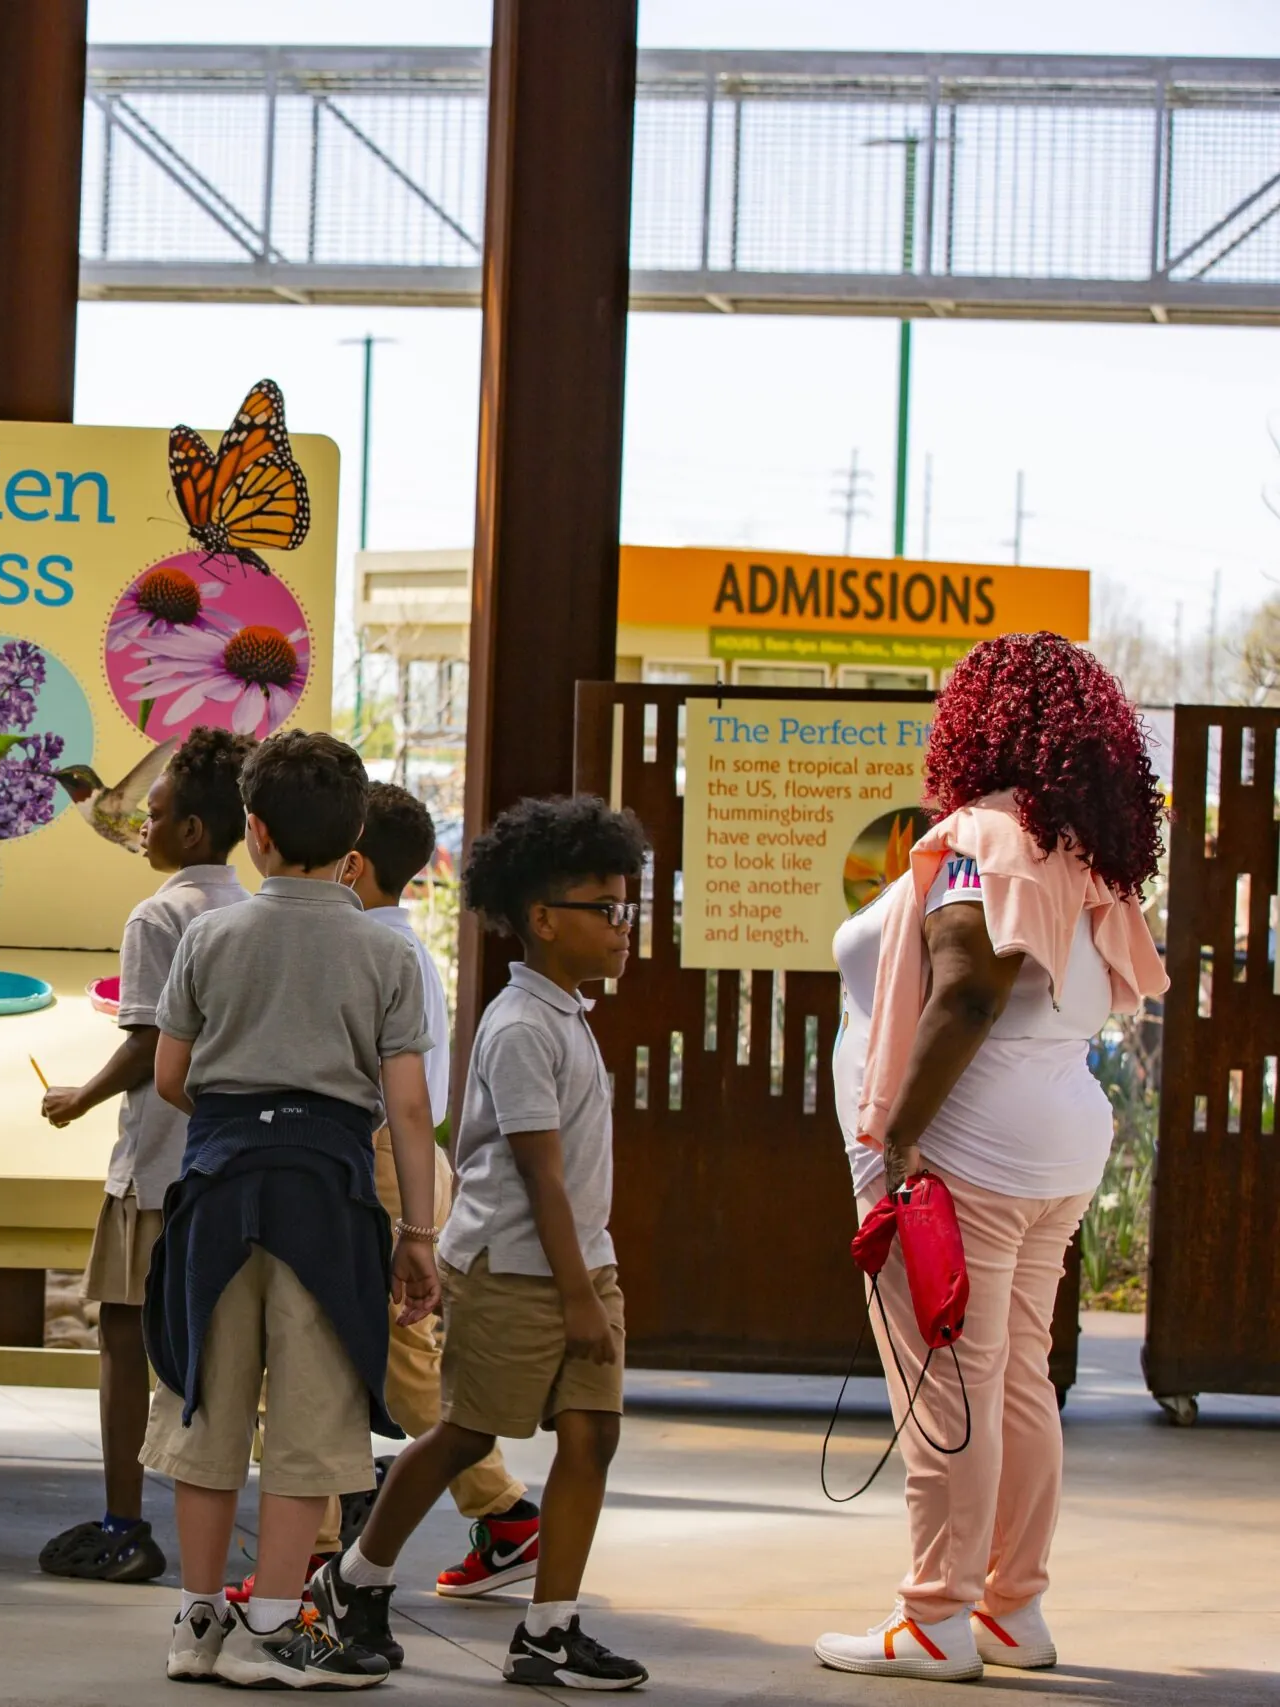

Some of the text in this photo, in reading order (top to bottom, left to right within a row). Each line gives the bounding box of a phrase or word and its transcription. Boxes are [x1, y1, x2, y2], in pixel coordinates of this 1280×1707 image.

[713, 562, 996, 625] ADMISSIONS
[709, 716, 769, 743] The
[779, 718, 887, 745] Perfect
[709, 755, 726, 773] In
[733, 760, 781, 775] some
[788, 757, 858, 778] tropical
[865, 762, 914, 776] areas
[708, 780, 893, 800] the US, flowers and
[707, 803, 834, 827] hummingbirds
[707, 828, 826, 847] have evolved
[707, 853, 812, 871] to look like
[706, 877, 822, 895] one another
[705, 900, 782, 923] in shape
[705, 924, 809, 948] and length.
